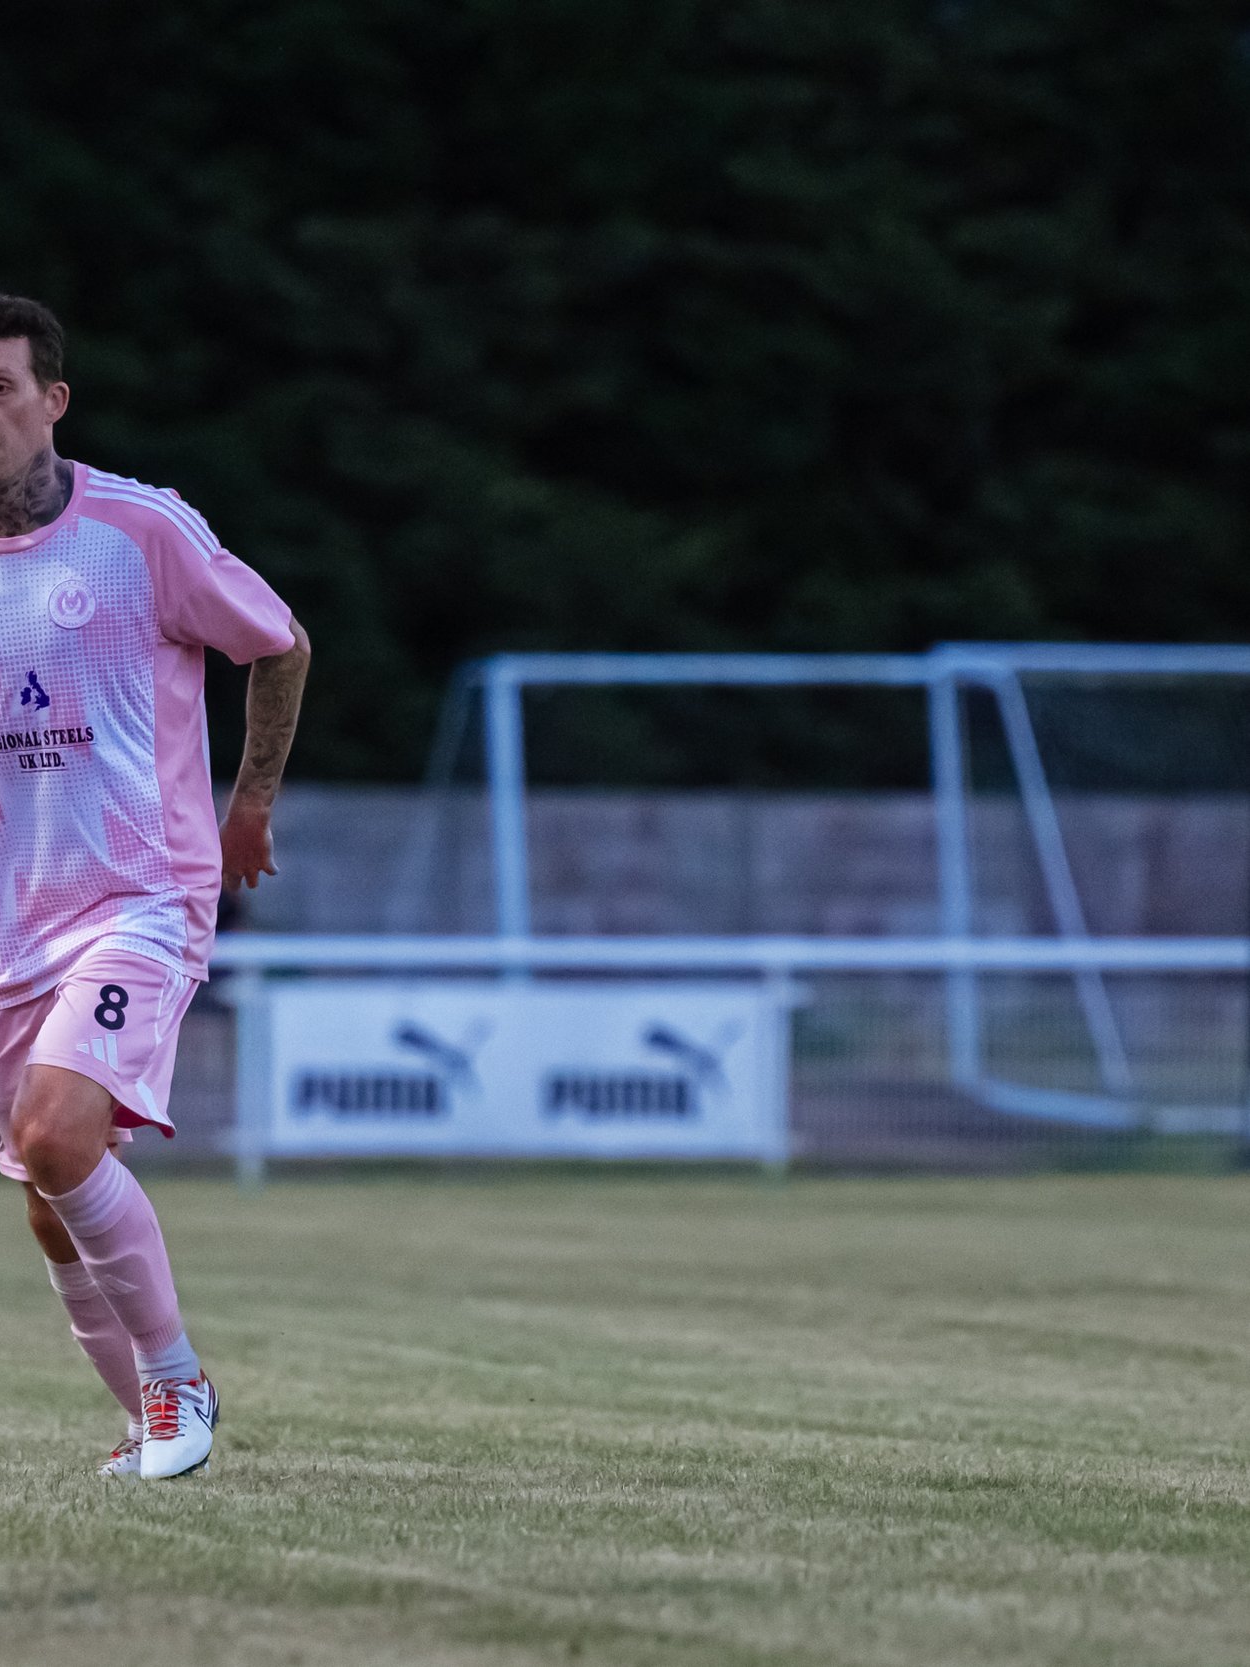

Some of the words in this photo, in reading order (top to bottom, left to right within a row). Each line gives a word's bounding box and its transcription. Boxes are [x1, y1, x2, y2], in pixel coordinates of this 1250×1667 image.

[44, 726, 95, 745] STEELS
[18, 754, 38, 769] UK
[40, 752, 66, 768] LTD.
[94, 984, 129, 1031] 8
